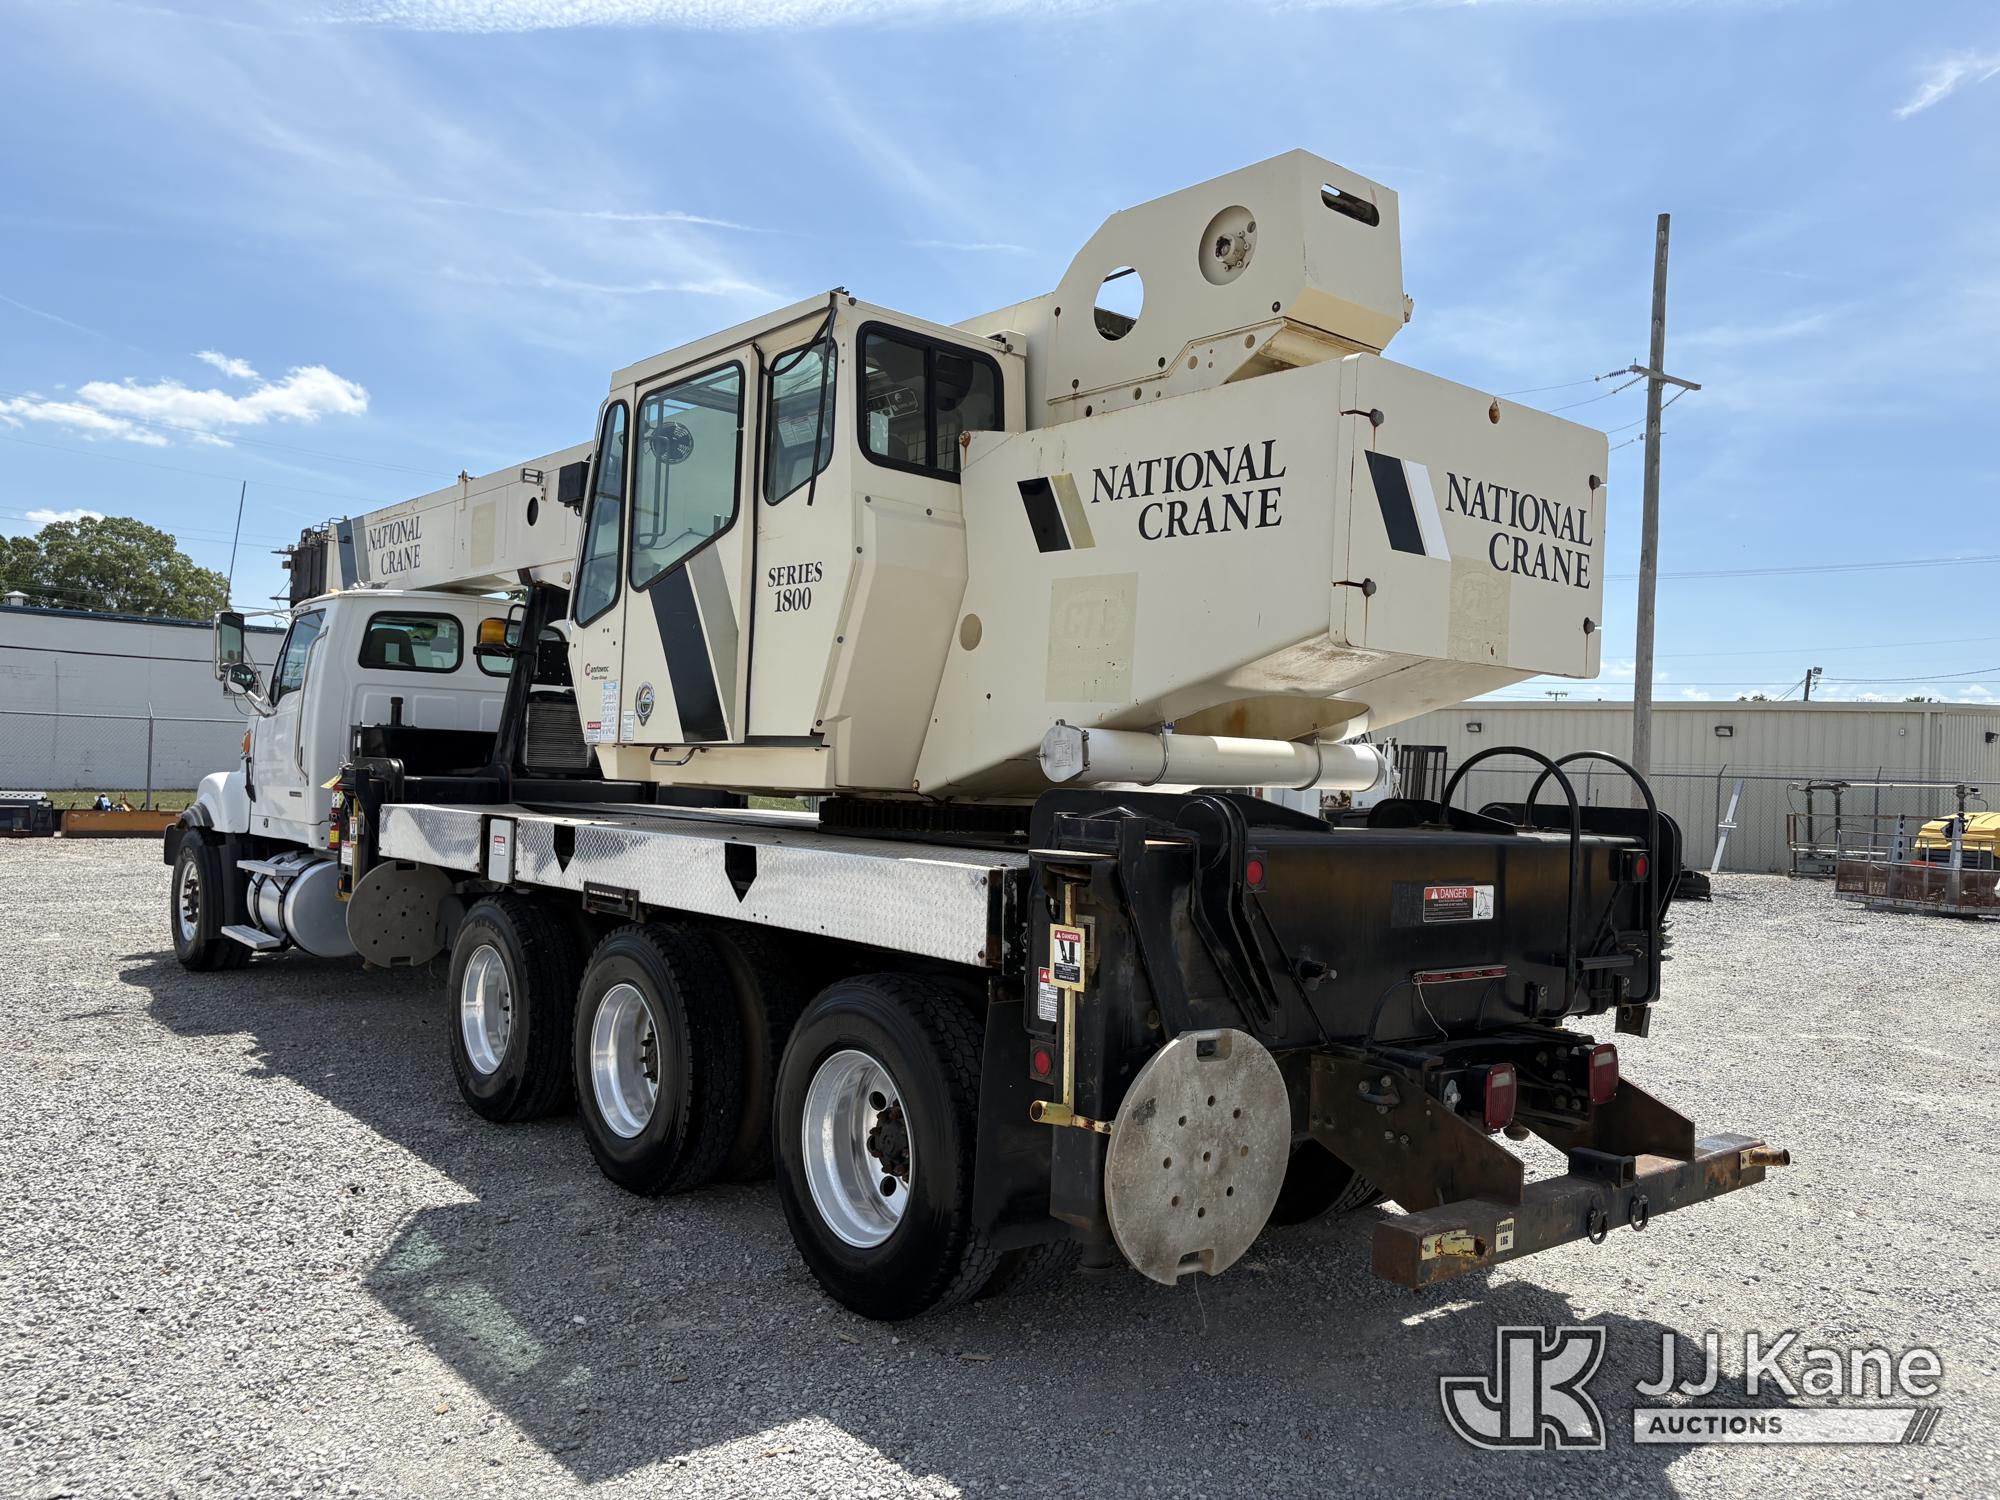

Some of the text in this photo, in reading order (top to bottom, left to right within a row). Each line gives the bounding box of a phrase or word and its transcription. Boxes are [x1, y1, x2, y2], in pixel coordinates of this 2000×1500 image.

[1091, 439, 1286, 503] NATIONAL
[1138, 487, 1282, 541] CRANE
[1445, 472, 1593, 547] NATIONAL
[368, 516, 422, 552] NATIONAL
[381, 544, 421, 575] CRANE
[768, 561, 823, 588] SERIES
[1489, 532, 1591, 589] CRANE
[774, 587, 811, 613] 1800
[1440, 888, 1468, 899] DANGER
